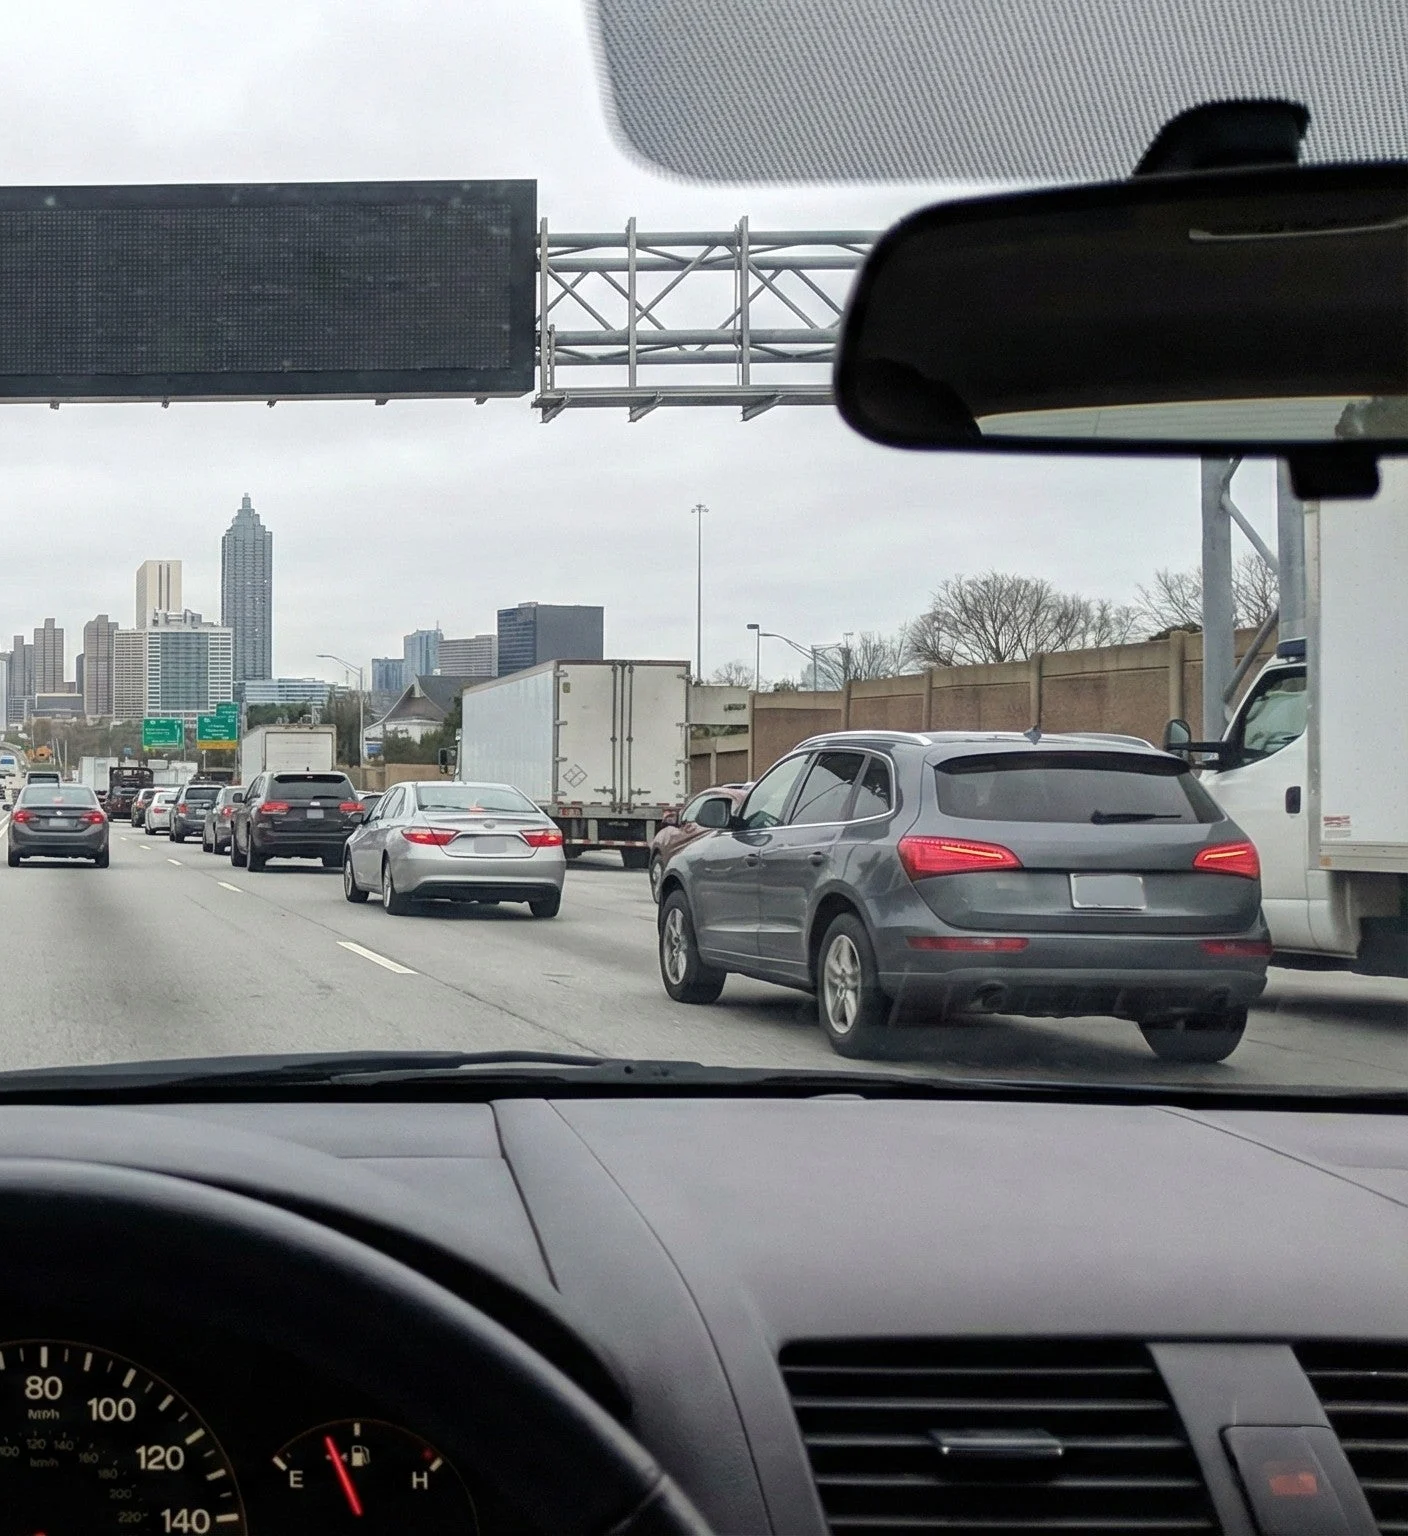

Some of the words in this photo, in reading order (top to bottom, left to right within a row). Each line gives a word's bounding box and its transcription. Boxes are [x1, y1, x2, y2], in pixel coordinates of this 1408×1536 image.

[24, 1375, 63, 1400] 80
[87, 1397, 136, 1422] 100
[135, 1445, 185, 1471] 120
[289, 1470, 304, 1488] E
[412, 1471, 428, 1490] H
[161, 1508, 211, 1535] 140
